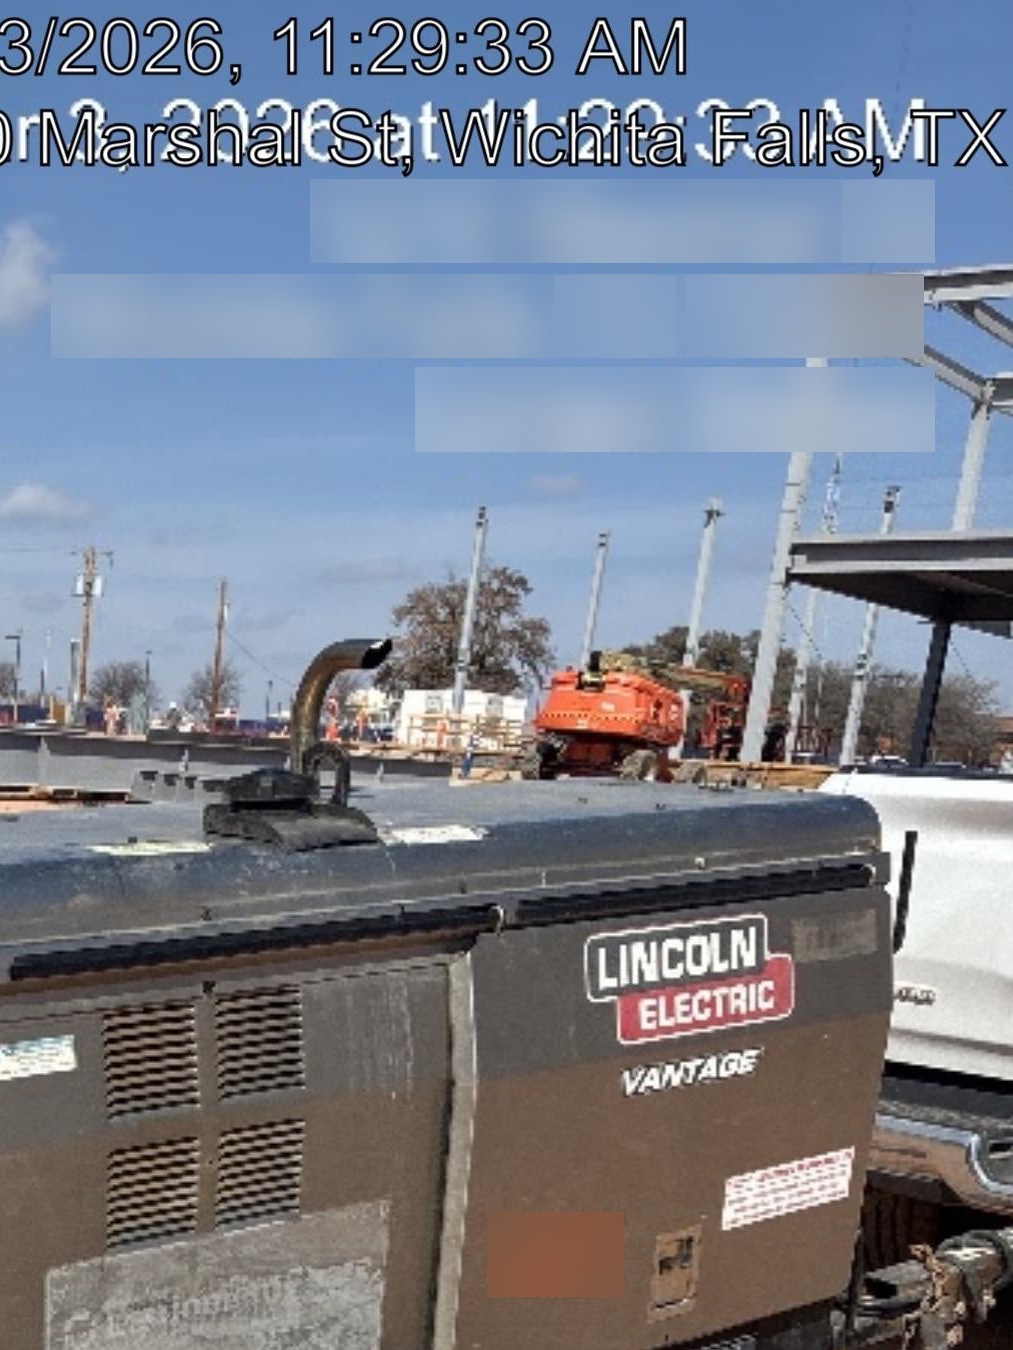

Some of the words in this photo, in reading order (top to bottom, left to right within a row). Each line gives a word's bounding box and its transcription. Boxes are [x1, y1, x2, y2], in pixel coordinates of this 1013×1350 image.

[598, 926, 757, 991] LINCOLN
[638, 980, 775, 1031] ELECTRIC
[622, 1048, 762, 1097] VANTAGE
